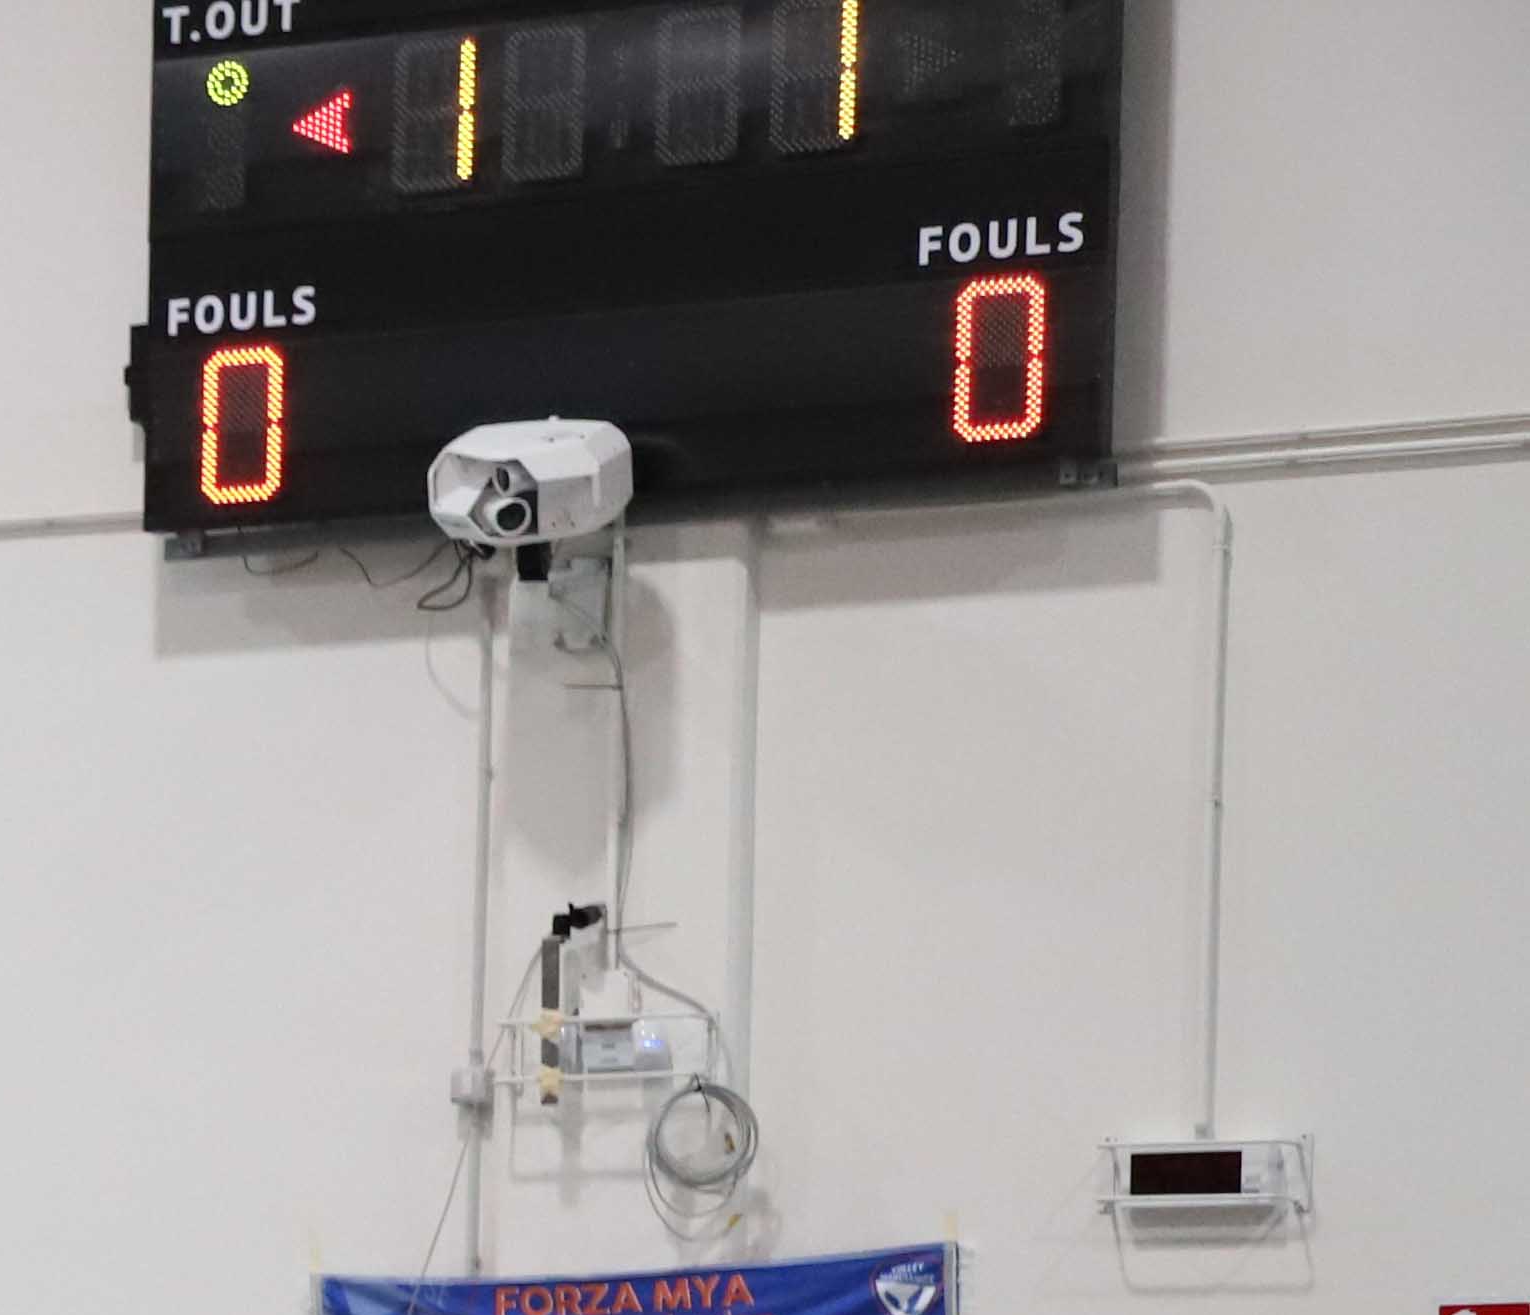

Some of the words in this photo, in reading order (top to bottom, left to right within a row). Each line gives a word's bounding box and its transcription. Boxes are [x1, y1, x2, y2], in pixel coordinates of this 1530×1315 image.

[162, 0, 302, 44] T.OUT
[917, 211, 1086, 268] FOULS
[166, 285, 318, 336] FOULS
[951, 273, 1046, 443] 0
[199, 343, 285, 506] 0
[653, 1273, 755, 1311] MYA
